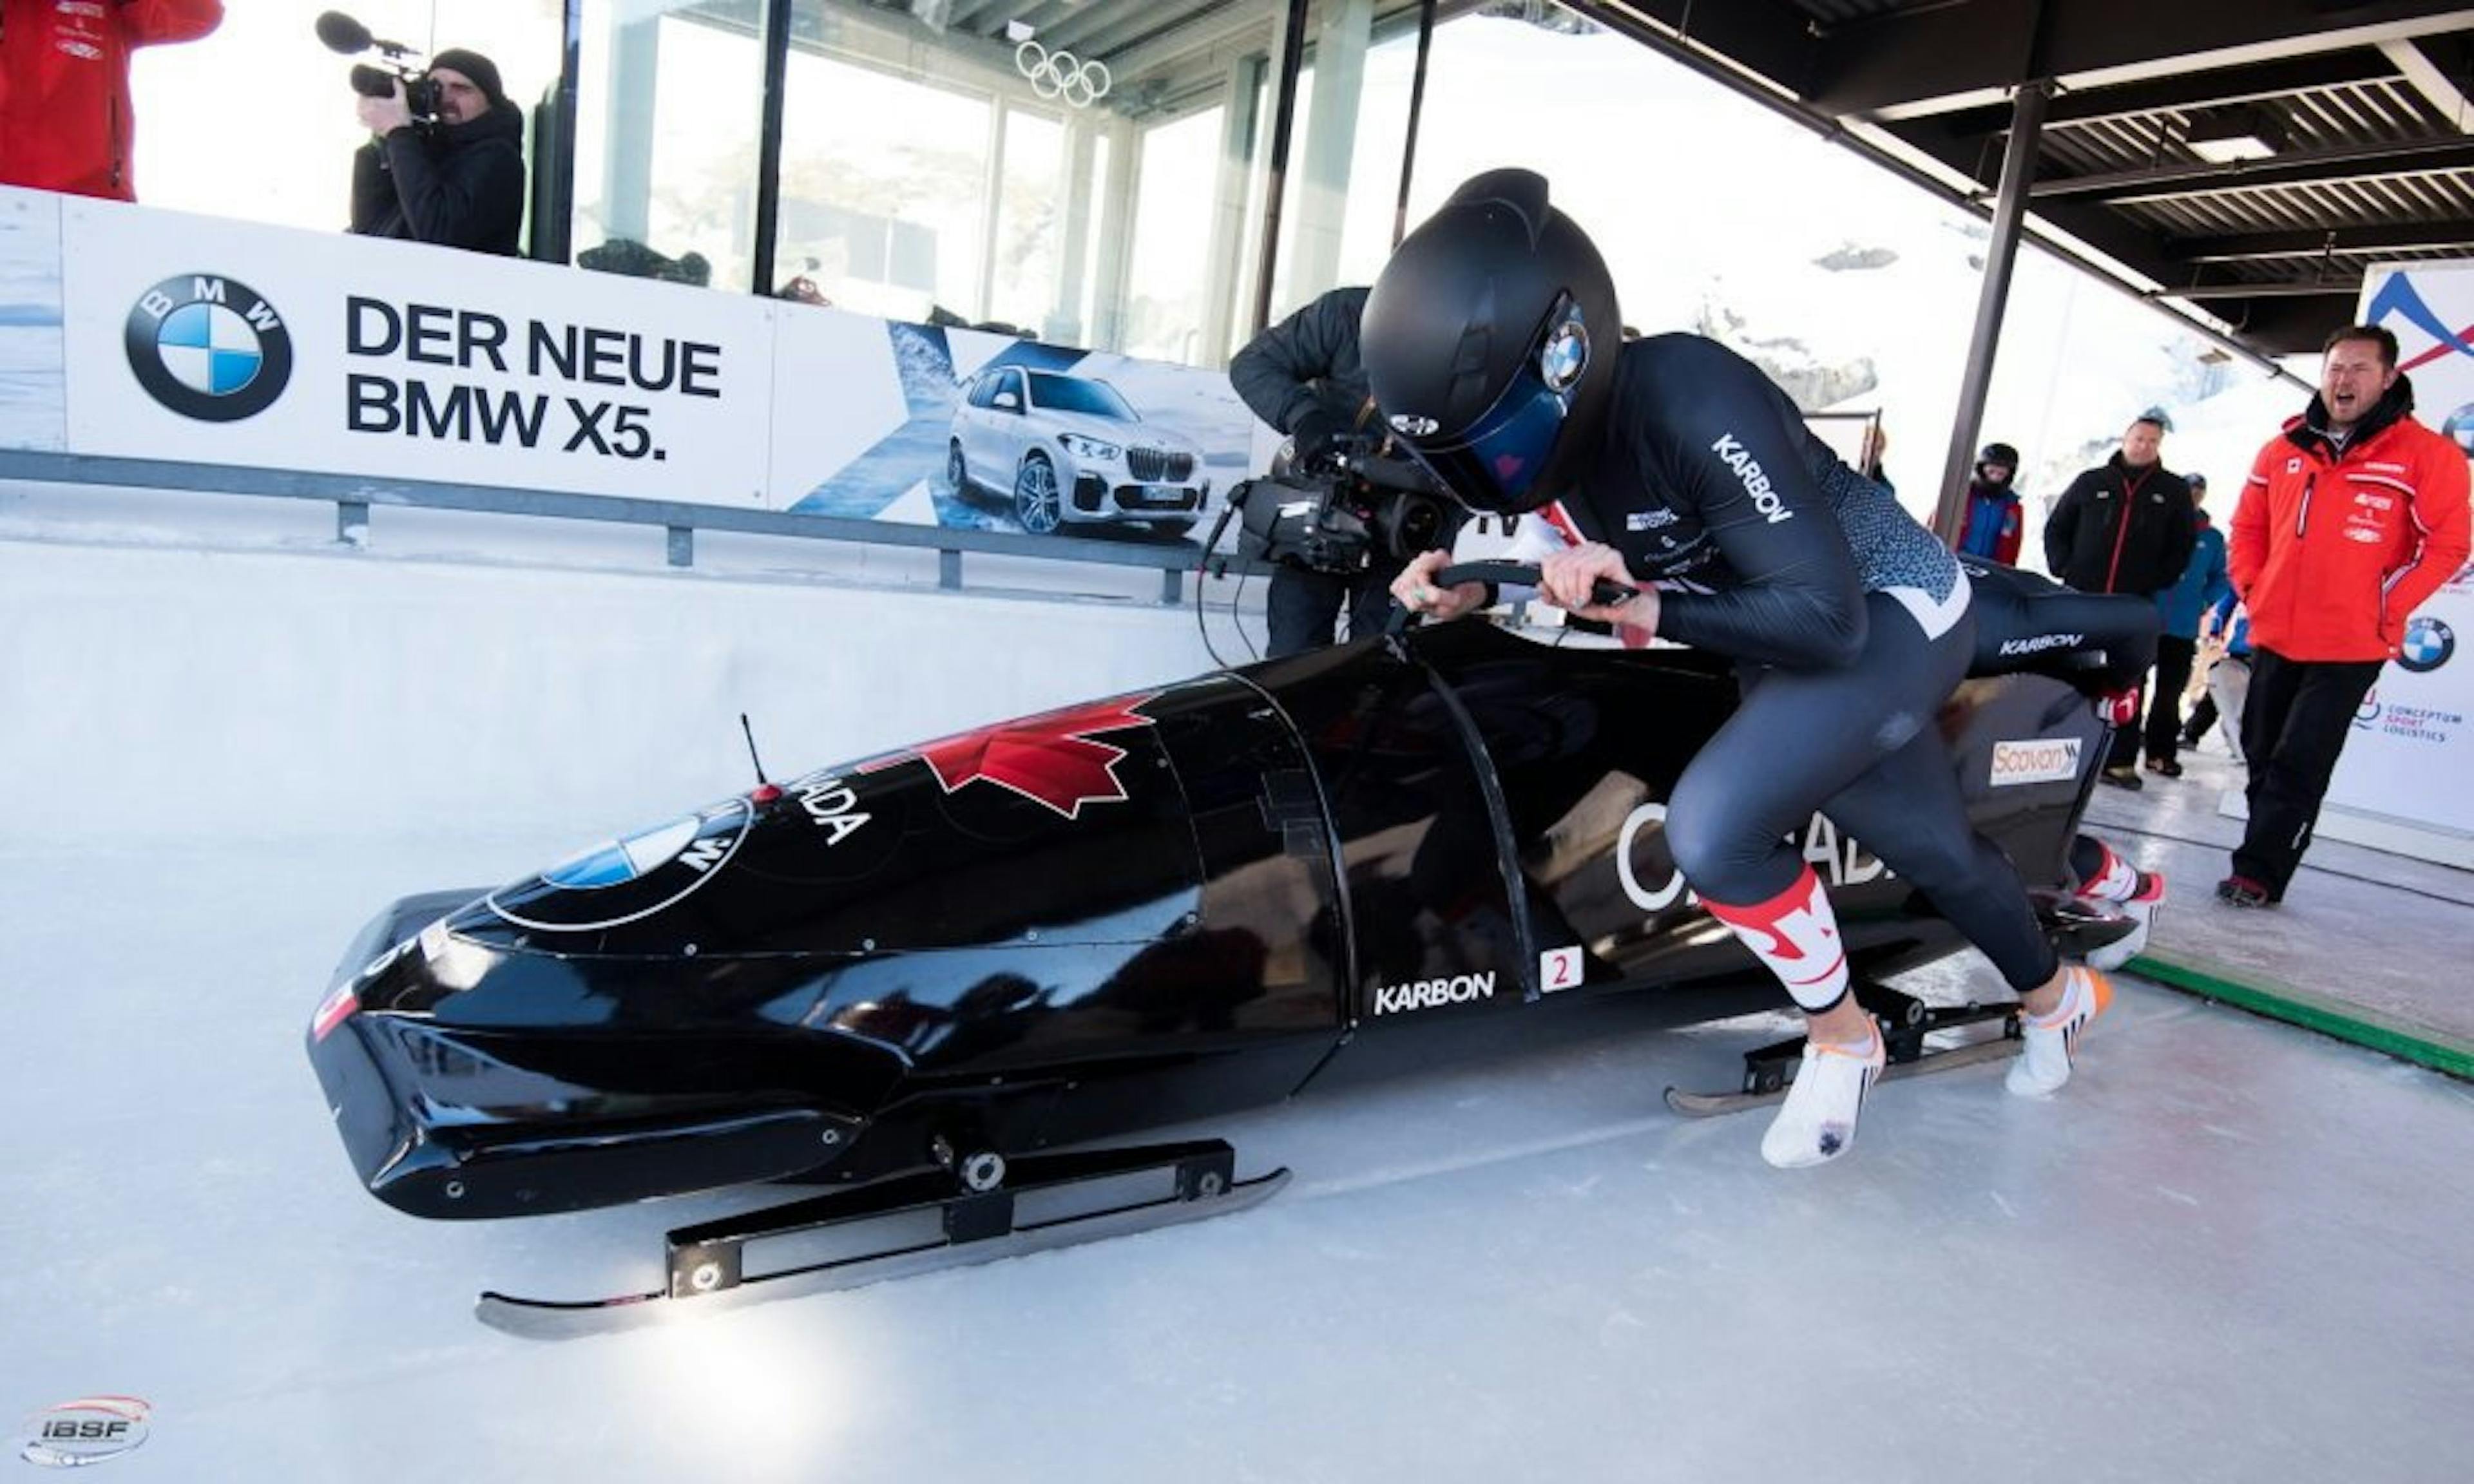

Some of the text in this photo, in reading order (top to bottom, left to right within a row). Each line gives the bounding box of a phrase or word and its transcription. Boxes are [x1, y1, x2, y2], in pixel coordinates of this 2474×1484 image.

[139, 276, 280, 333] BMW
[346, 294, 721, 399] DER NEUE
[347, 372, 667, 462] BMW X5.
[2383, 725, 2446, 742] LOGISTICS
[1374, 970, 1496, 1016] KARBON
[1553, 955, 1568, 984] 2
